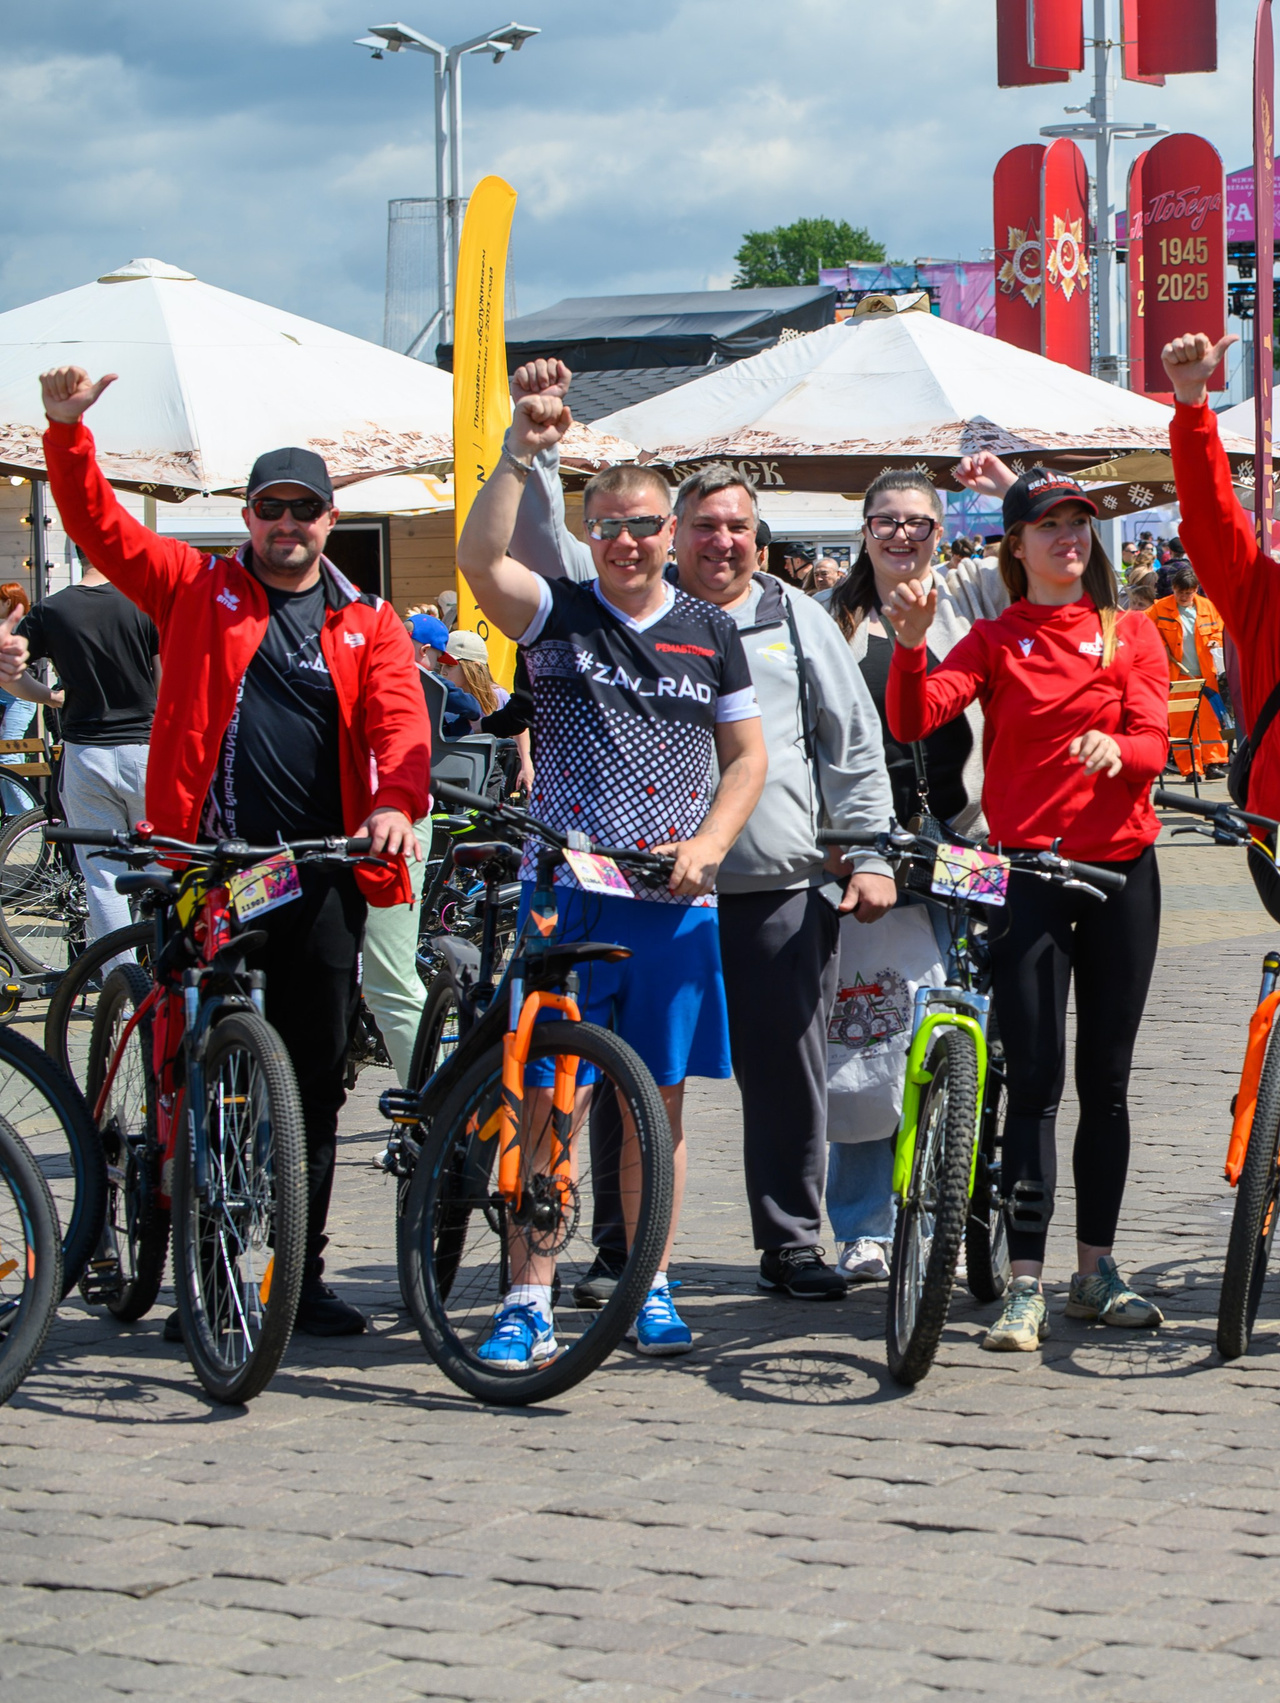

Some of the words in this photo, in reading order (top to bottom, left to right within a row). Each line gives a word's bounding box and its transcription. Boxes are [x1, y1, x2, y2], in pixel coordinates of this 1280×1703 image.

[1144, 186, 1221, 231] Победа
[1159, 237, 1208, 265] 1945
[1157, 273, 1209, 301] 2025
